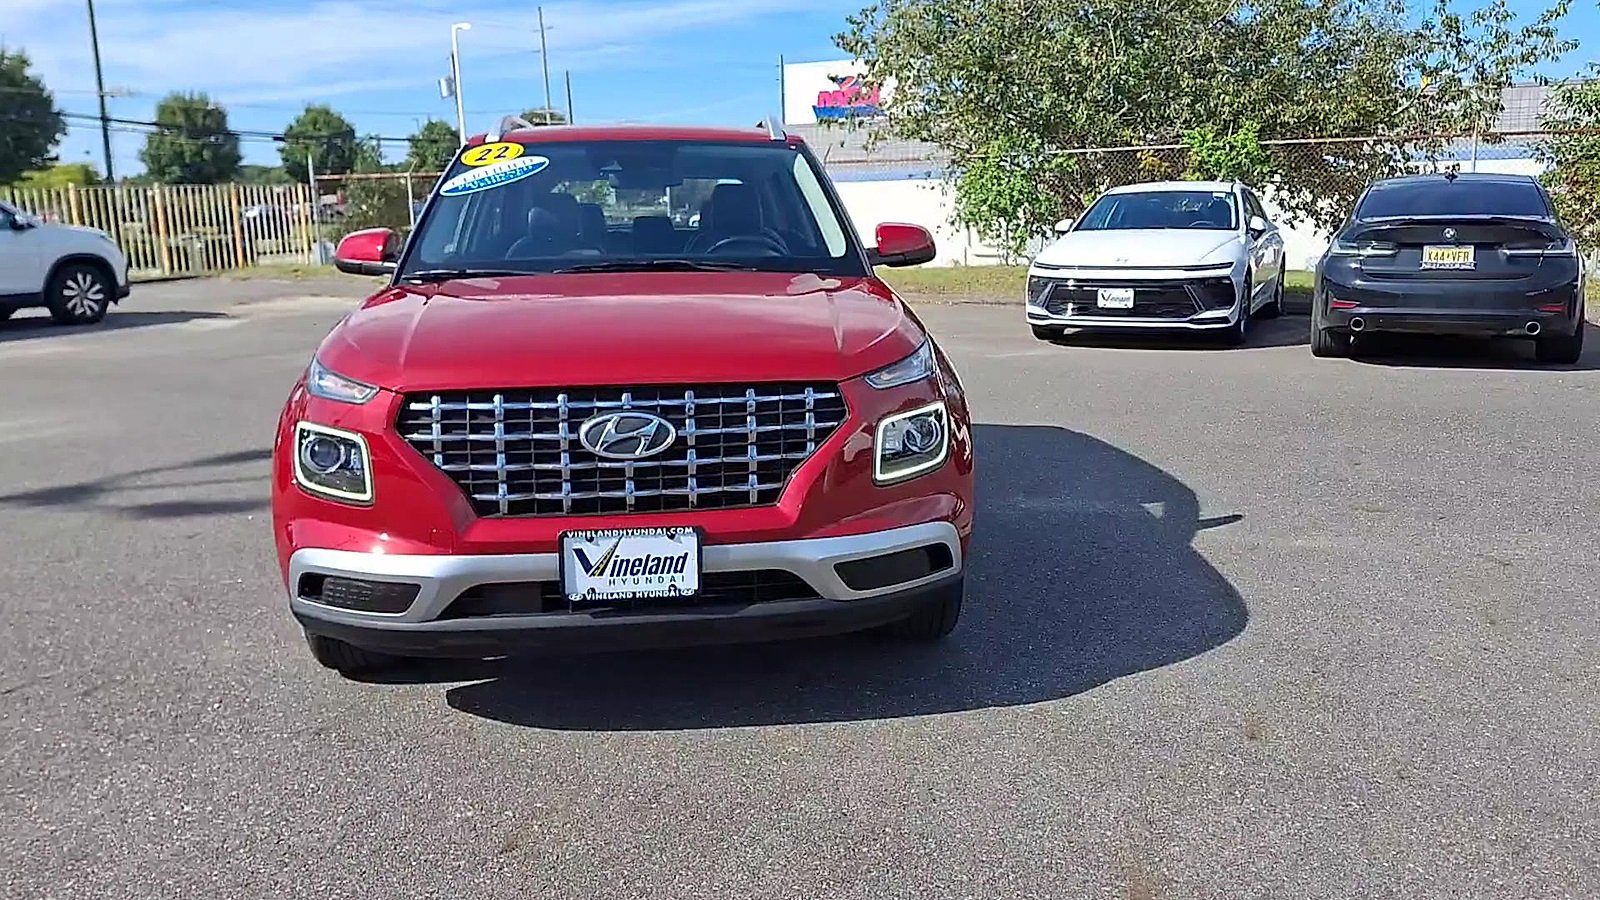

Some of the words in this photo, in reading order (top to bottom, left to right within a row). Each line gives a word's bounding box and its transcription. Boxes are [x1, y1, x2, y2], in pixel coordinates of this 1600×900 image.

[474, 146, 510, 162] 22
[566, 526, 694, 538] VINELANDHYUNDAI.COM
[572, 536, 689, 578] Vineland
[608, 575, 685, 587] HYUNDAI
[585, 590, 634, 601] VINELAND
[636, 588, 680, 599] HYUNDAI
